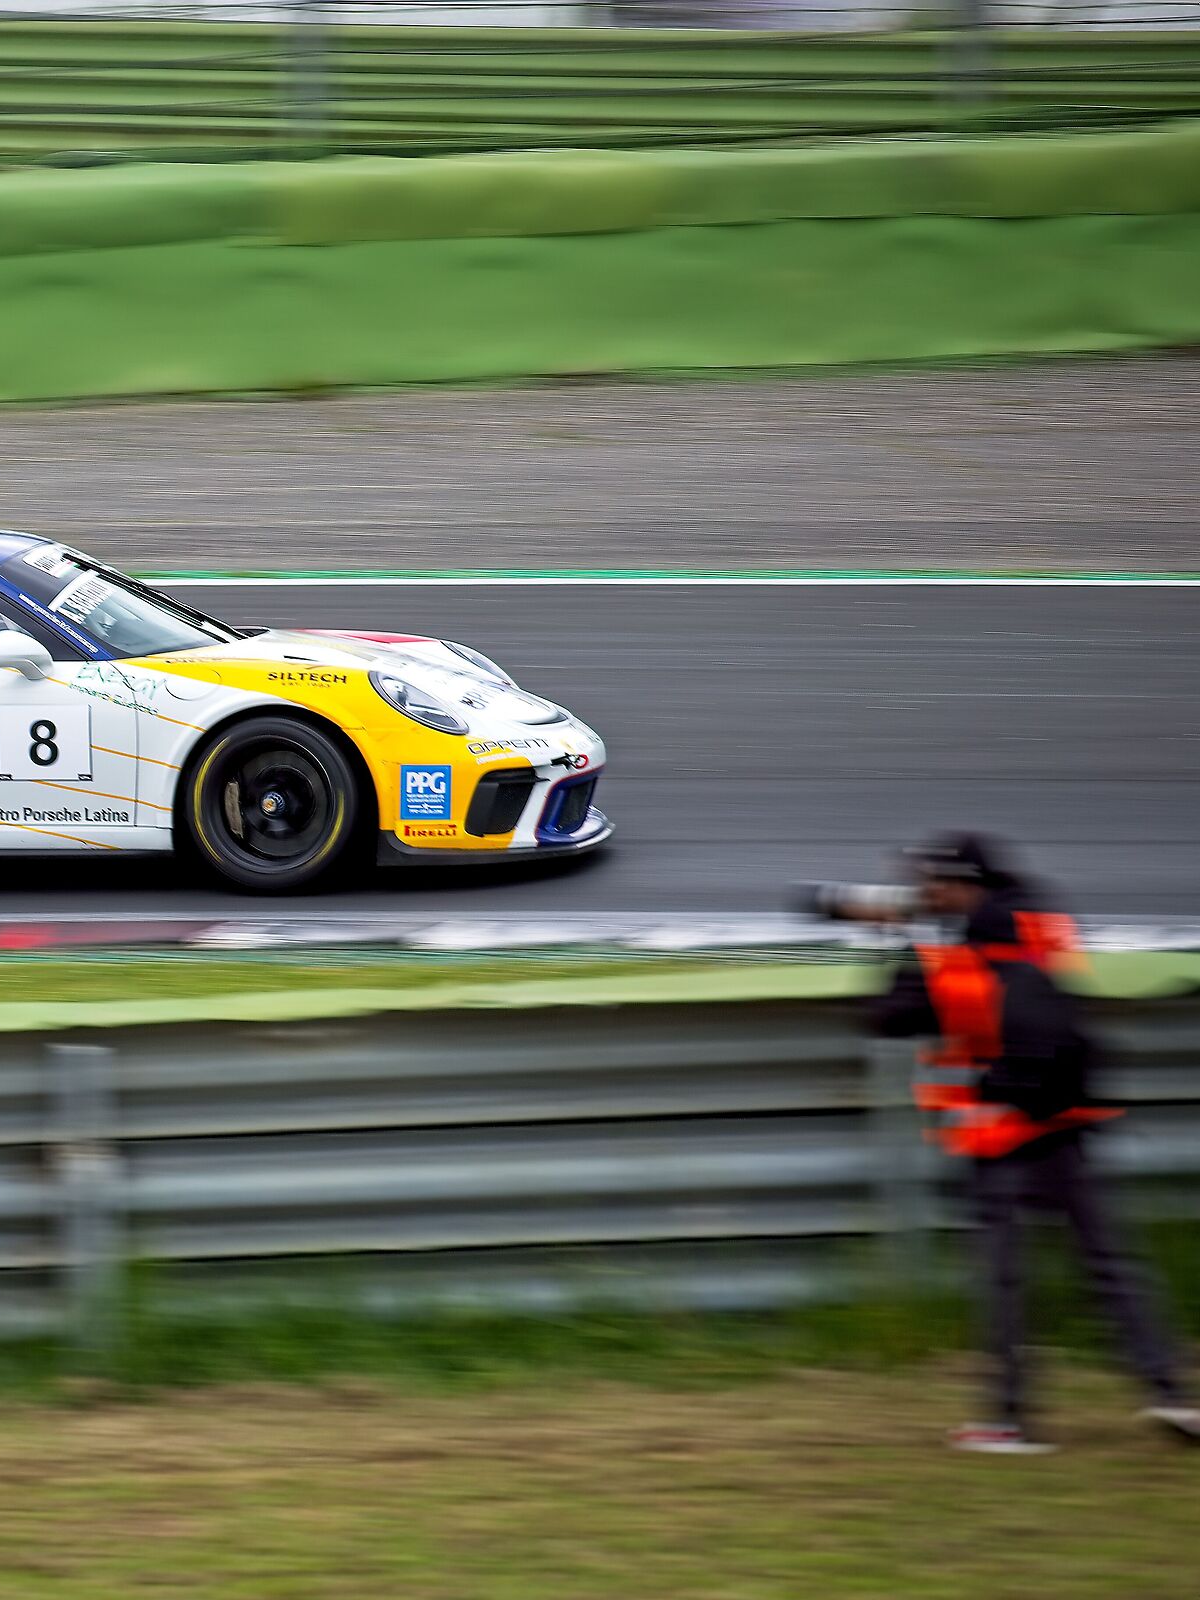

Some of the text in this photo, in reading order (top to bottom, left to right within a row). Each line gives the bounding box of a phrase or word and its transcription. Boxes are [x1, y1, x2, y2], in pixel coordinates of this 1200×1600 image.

[267, 671, 348, 685] SILTECH
[29, 719, 59, 767] 8
[406, 771, 446, 794] PPG
[23, 806, 81, 822] Porsche
[84, 806, 129, 822] Latina
